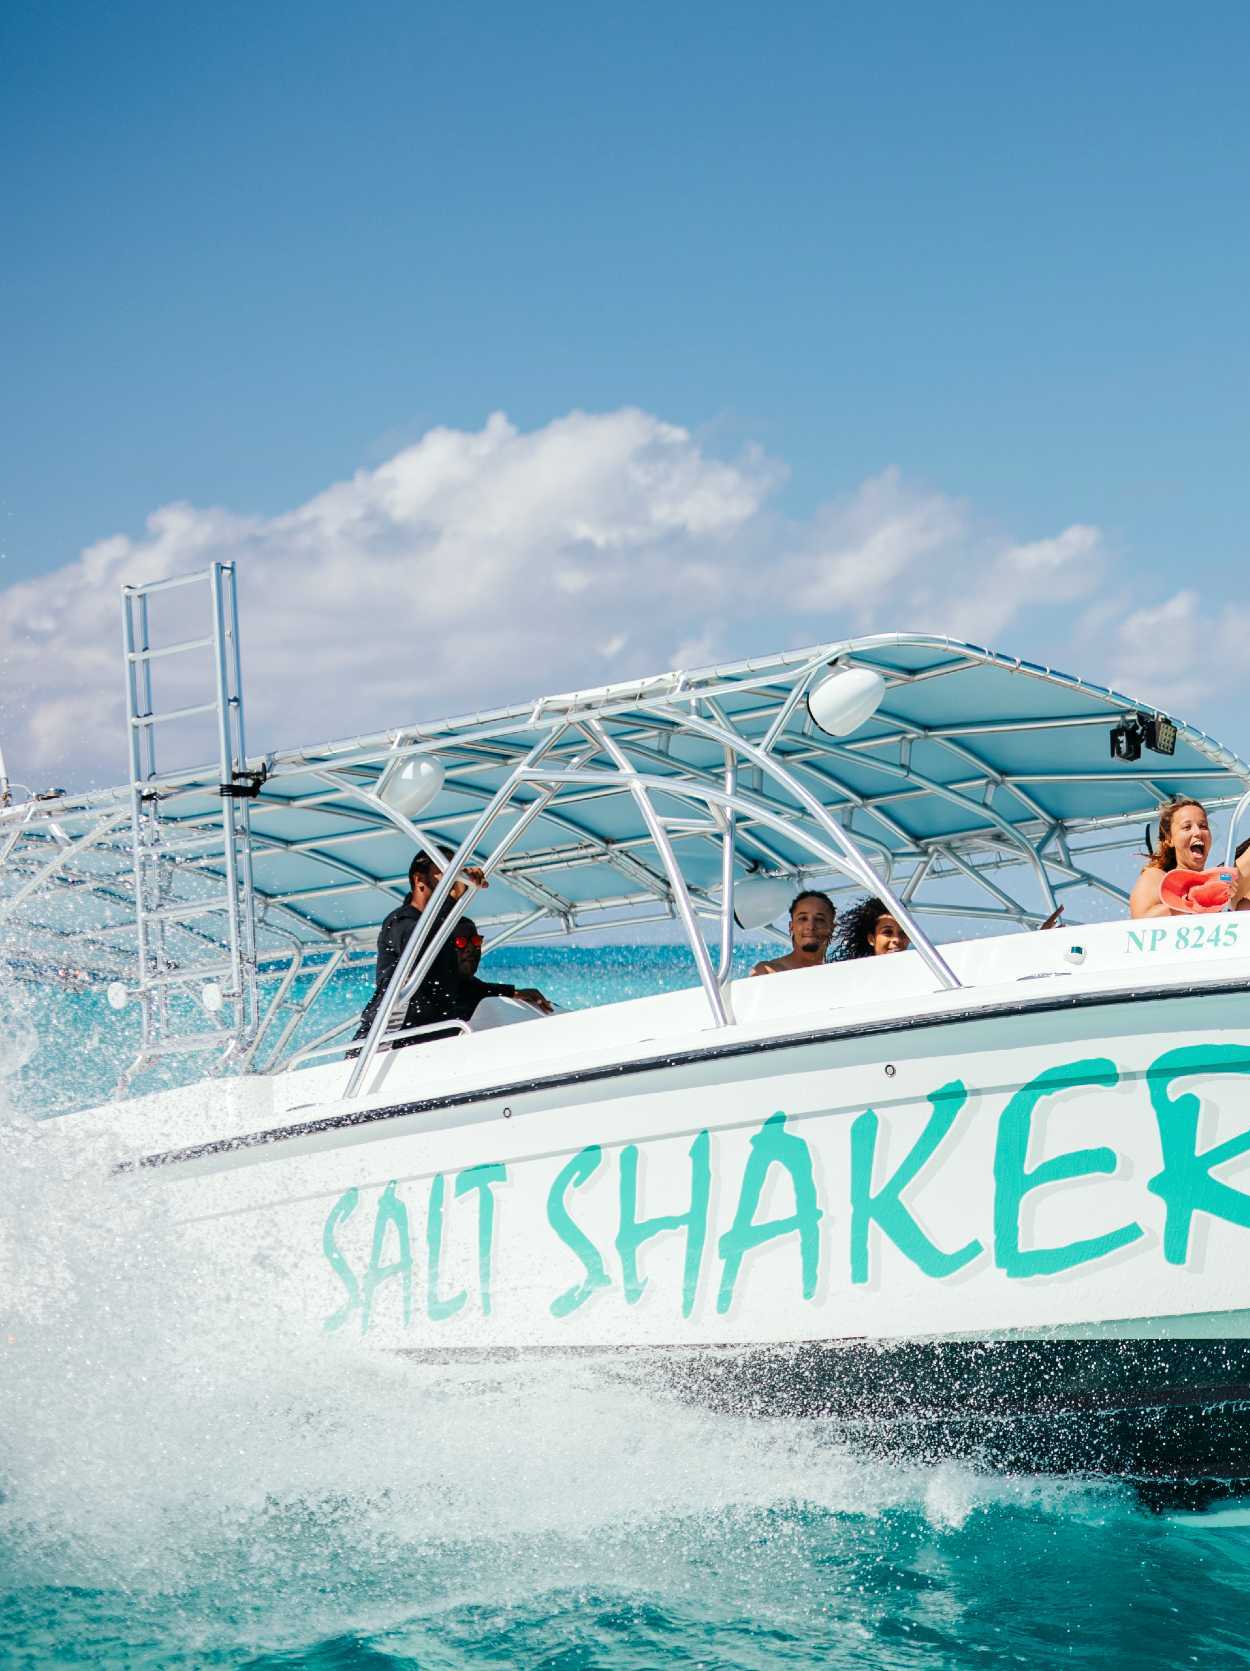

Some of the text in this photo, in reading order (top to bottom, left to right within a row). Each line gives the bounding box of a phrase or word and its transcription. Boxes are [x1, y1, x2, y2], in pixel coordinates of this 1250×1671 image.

[1126, 924, 1239, 953] NP 8245
[322, 1162, 508, 1335] SALT
